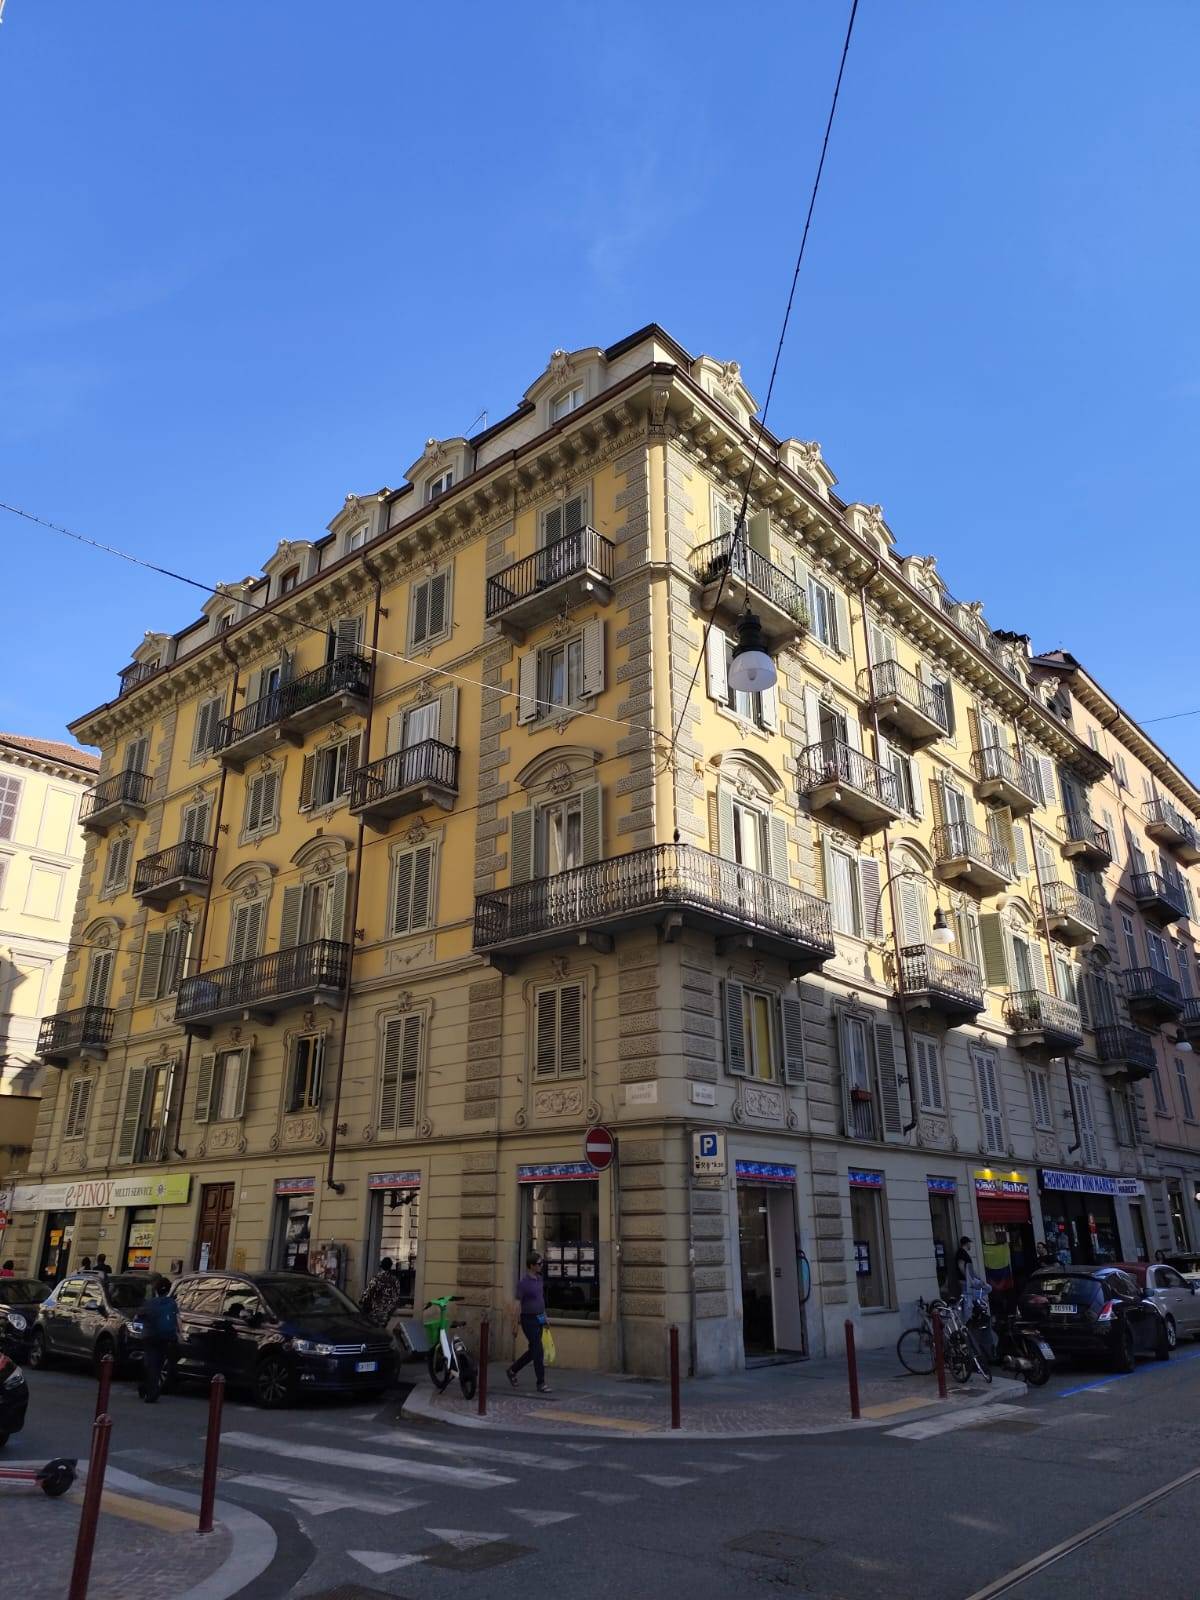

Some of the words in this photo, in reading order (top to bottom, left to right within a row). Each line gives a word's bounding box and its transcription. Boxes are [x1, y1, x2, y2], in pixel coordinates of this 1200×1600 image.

[703, 1137, 713, 1154] P
[1044, 1172, 1080, 1190] CHOWDHURY
[1095, 1177, 1116, 1194] MARKET
